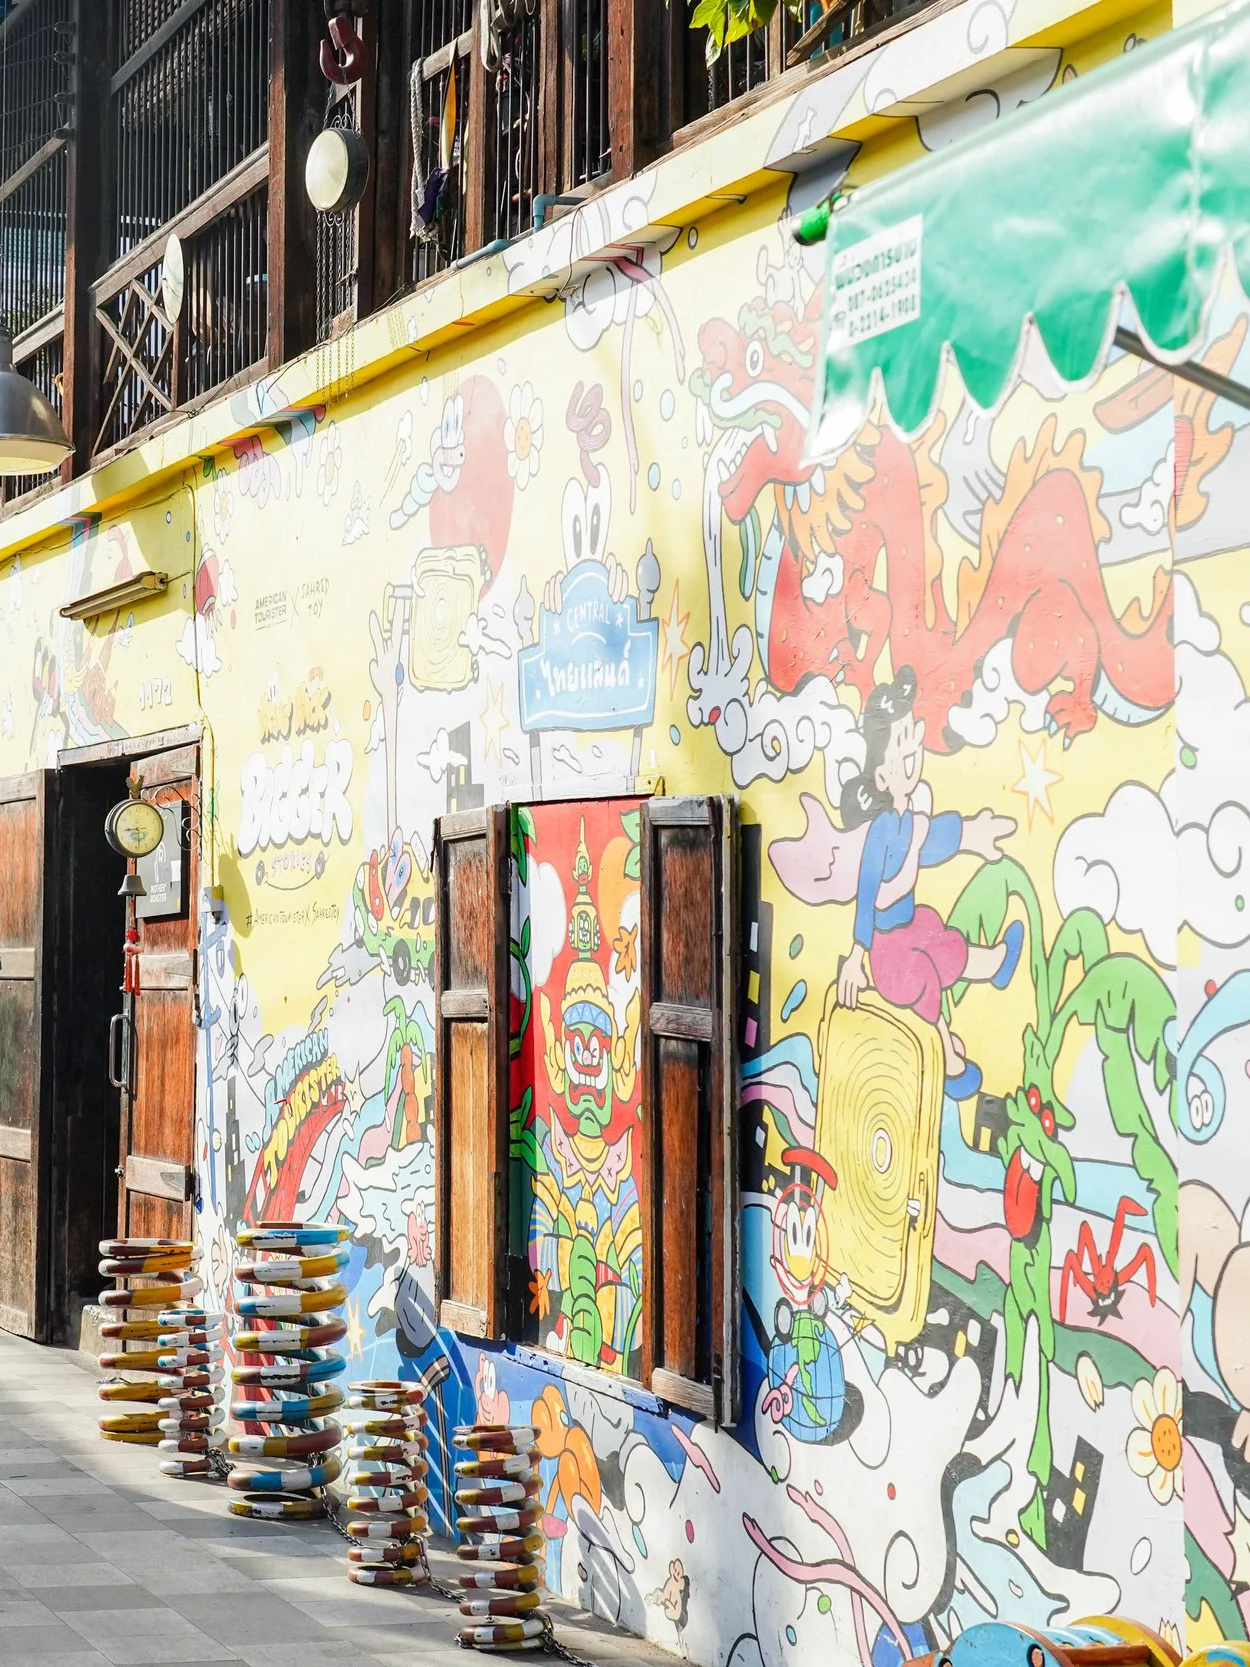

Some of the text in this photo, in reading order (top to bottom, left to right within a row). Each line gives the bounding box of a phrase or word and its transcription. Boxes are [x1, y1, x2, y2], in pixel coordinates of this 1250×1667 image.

[254, 589, 288, 611] AMERICAN
[254, 599, 324, 625] TOURISTER TOY
[566, 601, 611, 633] CENTRAL
[539, 639, 632, 697] ไทยแลนด์
[237, 738, 354, 860] BIGGER
[271, 850, 312, 879] STORIES
[262, 1027, 329, 1144] AMERICAN
[263, 1053, 341, 1190] TOURISTER
